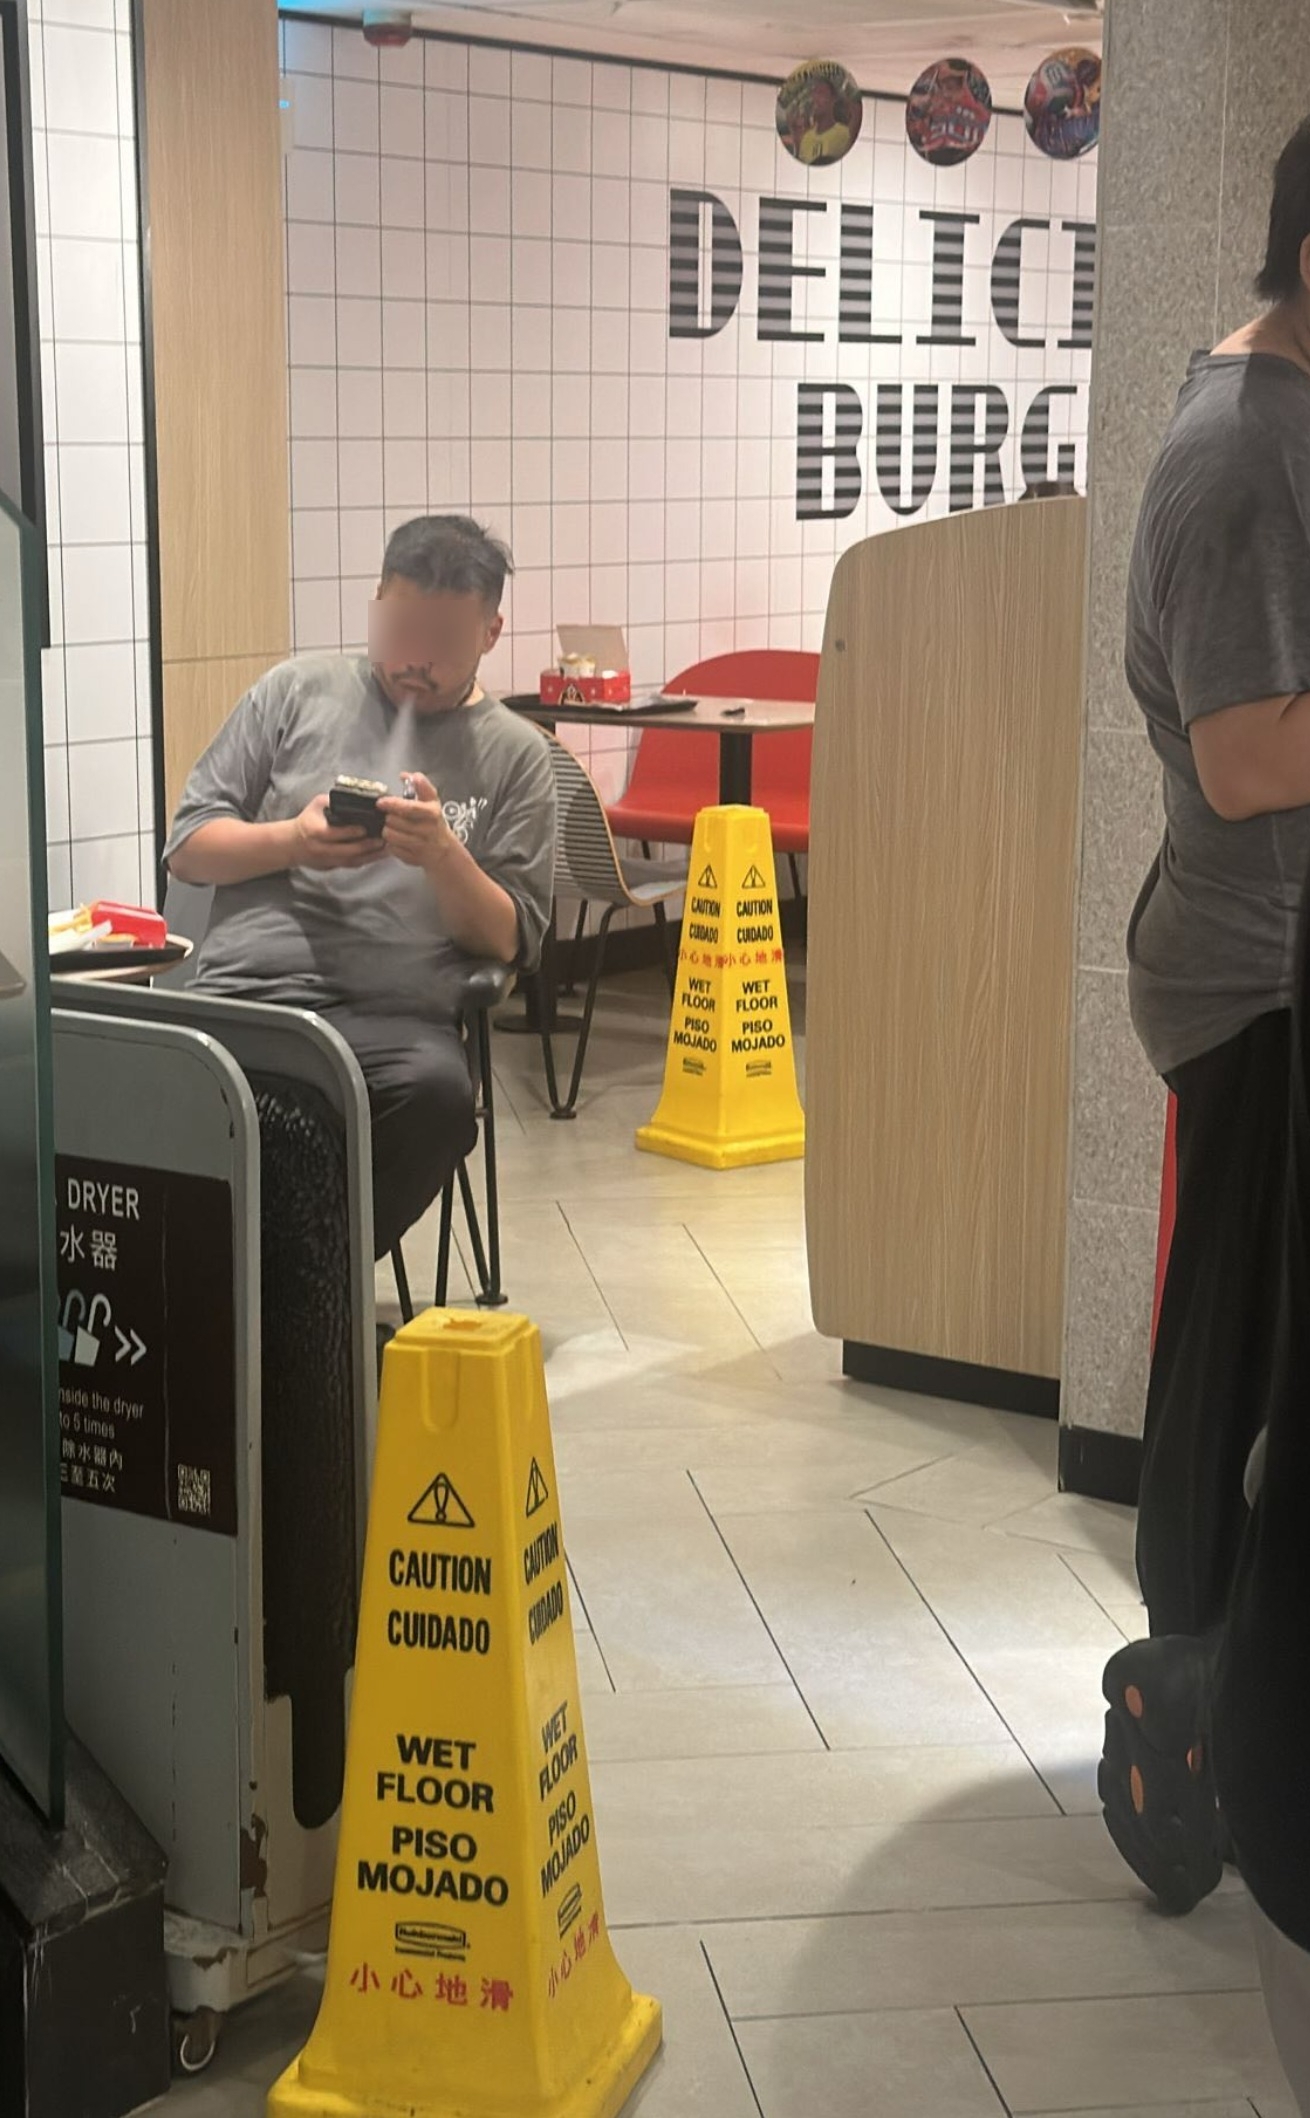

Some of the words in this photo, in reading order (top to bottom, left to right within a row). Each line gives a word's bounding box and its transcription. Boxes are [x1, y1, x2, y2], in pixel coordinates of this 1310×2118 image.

[691, 896, 721, 918] CAUTION
[736, 898, 773, 918] CAUTION
[689, 922, 719, 944] CUIDADO
[737, 925, 774, 944] CUIDADO
[681, 992, 716, 1013] FLOOR
[688, 976, 711, 995] WET
[742, 979, 771, 995] WET
[735, 995, 778, 1013] FLOOR
[673, 1030, 718, 1054] MOJADO
[684, 1016, 710, 1035] PISO
[742, 1018, 773, 1035] PISO
[731, 1034, 786, 1053] MOJADO
[67, 1177, 140, 1220] DRYER
[92, 1391, 110, 1413] the
[114, 1396, 145, 1421] dryer
[73, 1411, 81, 1433] 5
[84, 1415, 116, 1440] times
[523, 1522, 560, 1586] CAUTION
[389, 1549, 492, 1596] CAUTION
[528, 1580, 564, 1646] CUIDADO
[387, 1609, 491, 1655] CUIDADO
[541, 1701, 568, 1754] WET
[396, 1733, 477, 1771] WET
[538, 1733, 578, 1802] FLOOR
[376, 1771, 494, 1814] FLOOR
[548, 1789, 577, 1846] PISO
[391, 1825, 478, 1864] PISO
[540, 1814, 590, 1899] MOJADO
[357, 1860, 509, 1908] MOJADO
[350, 1962, 514, 2012] 小心地滑
